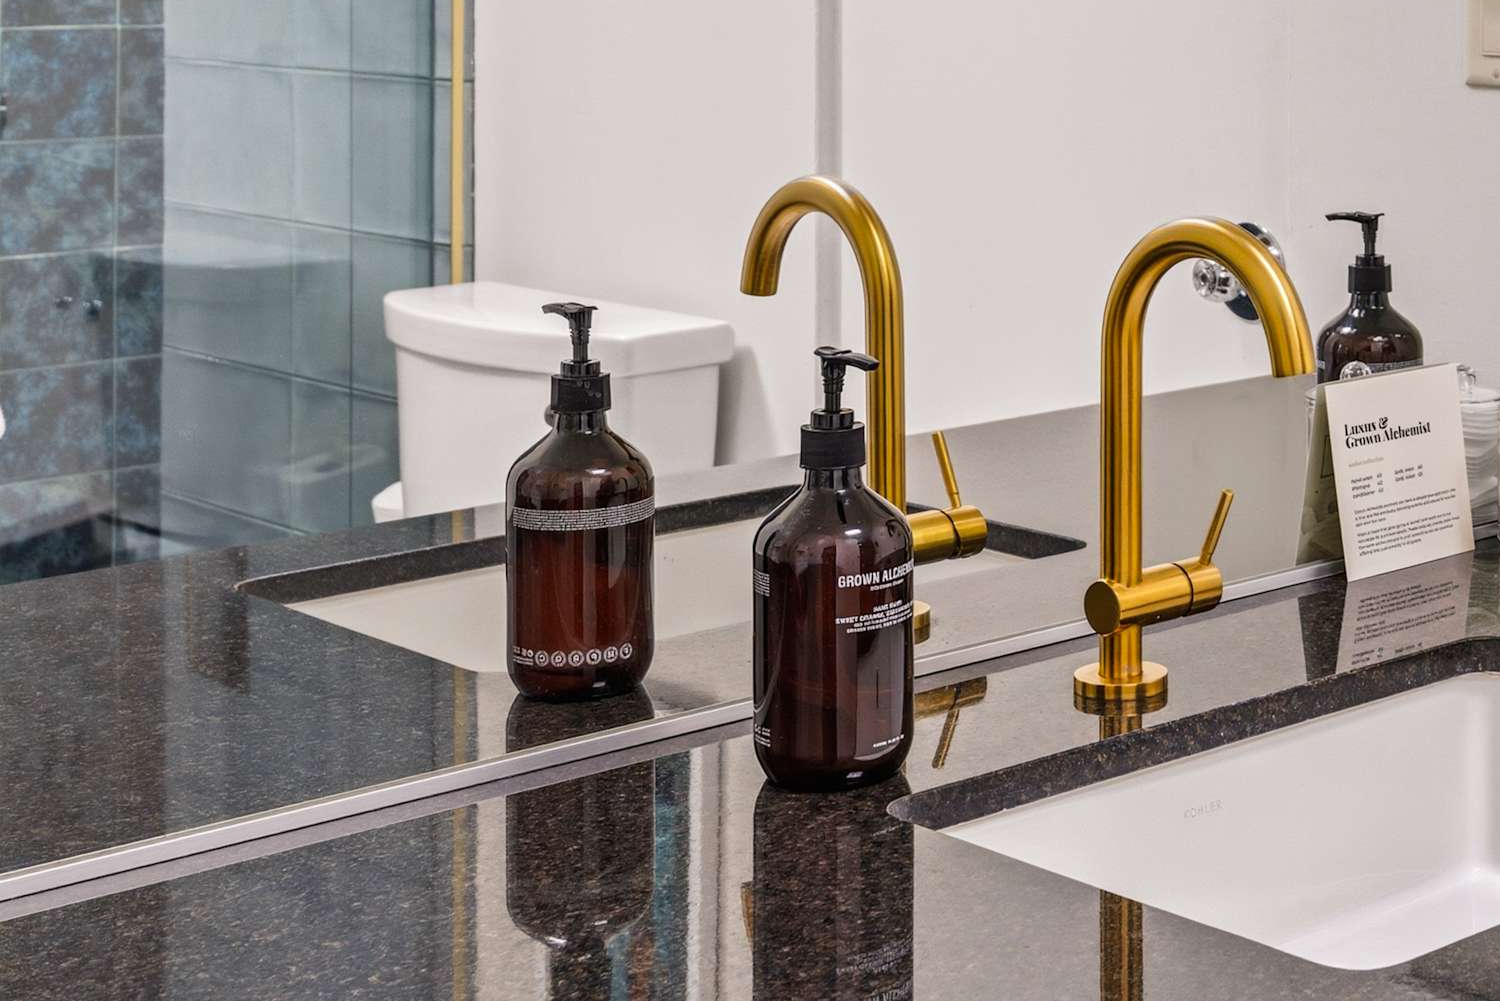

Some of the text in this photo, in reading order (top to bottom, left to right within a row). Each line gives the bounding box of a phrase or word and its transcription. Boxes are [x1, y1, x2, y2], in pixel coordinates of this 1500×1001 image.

[1344, 416, 1389, 437] Luxus &
[1345, 421, 1431, 449] Grown Alchemist
[837, 570, 880, 588] GROWN
